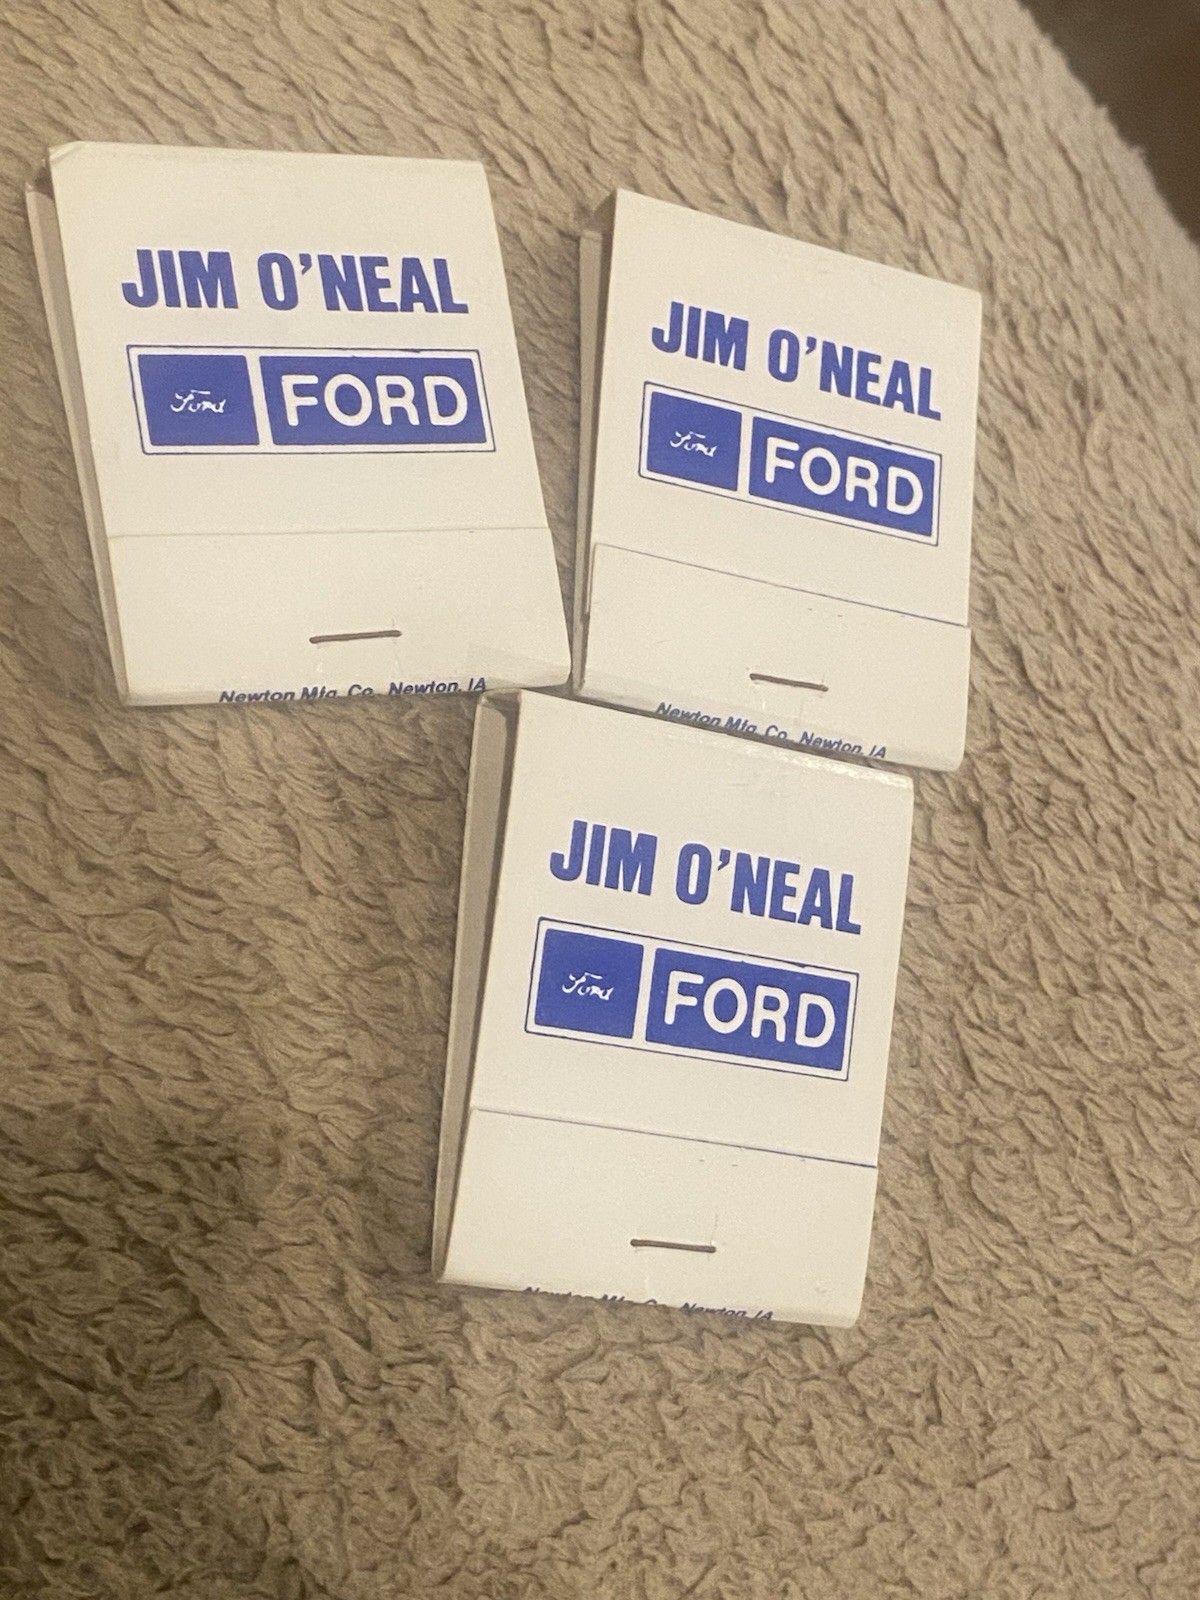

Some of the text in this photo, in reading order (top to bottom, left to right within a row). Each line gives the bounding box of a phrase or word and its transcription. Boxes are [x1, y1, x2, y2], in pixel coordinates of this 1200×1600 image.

[123, 249, 467, 312] JIM O'NEAL
[652, 301, 941, 419] JIM O'NEAL
[170, 389, 226, 414] Ford
[281, 373, 468, 427] FORD
[669, 431, 717, 458] Ford
[764, 436, 924, 516] FORD
[219, 689, 295, 703] Newton
[468, 677, 487, 692] IA
[656, 701, 722, 727] Newton
[869, 744, 887, 759] IA
[550, 820, 860, 933] JIM O'NEAL
[561, 971, 615, 1001] Ford
[664, 970, 836, 1048] FORD
